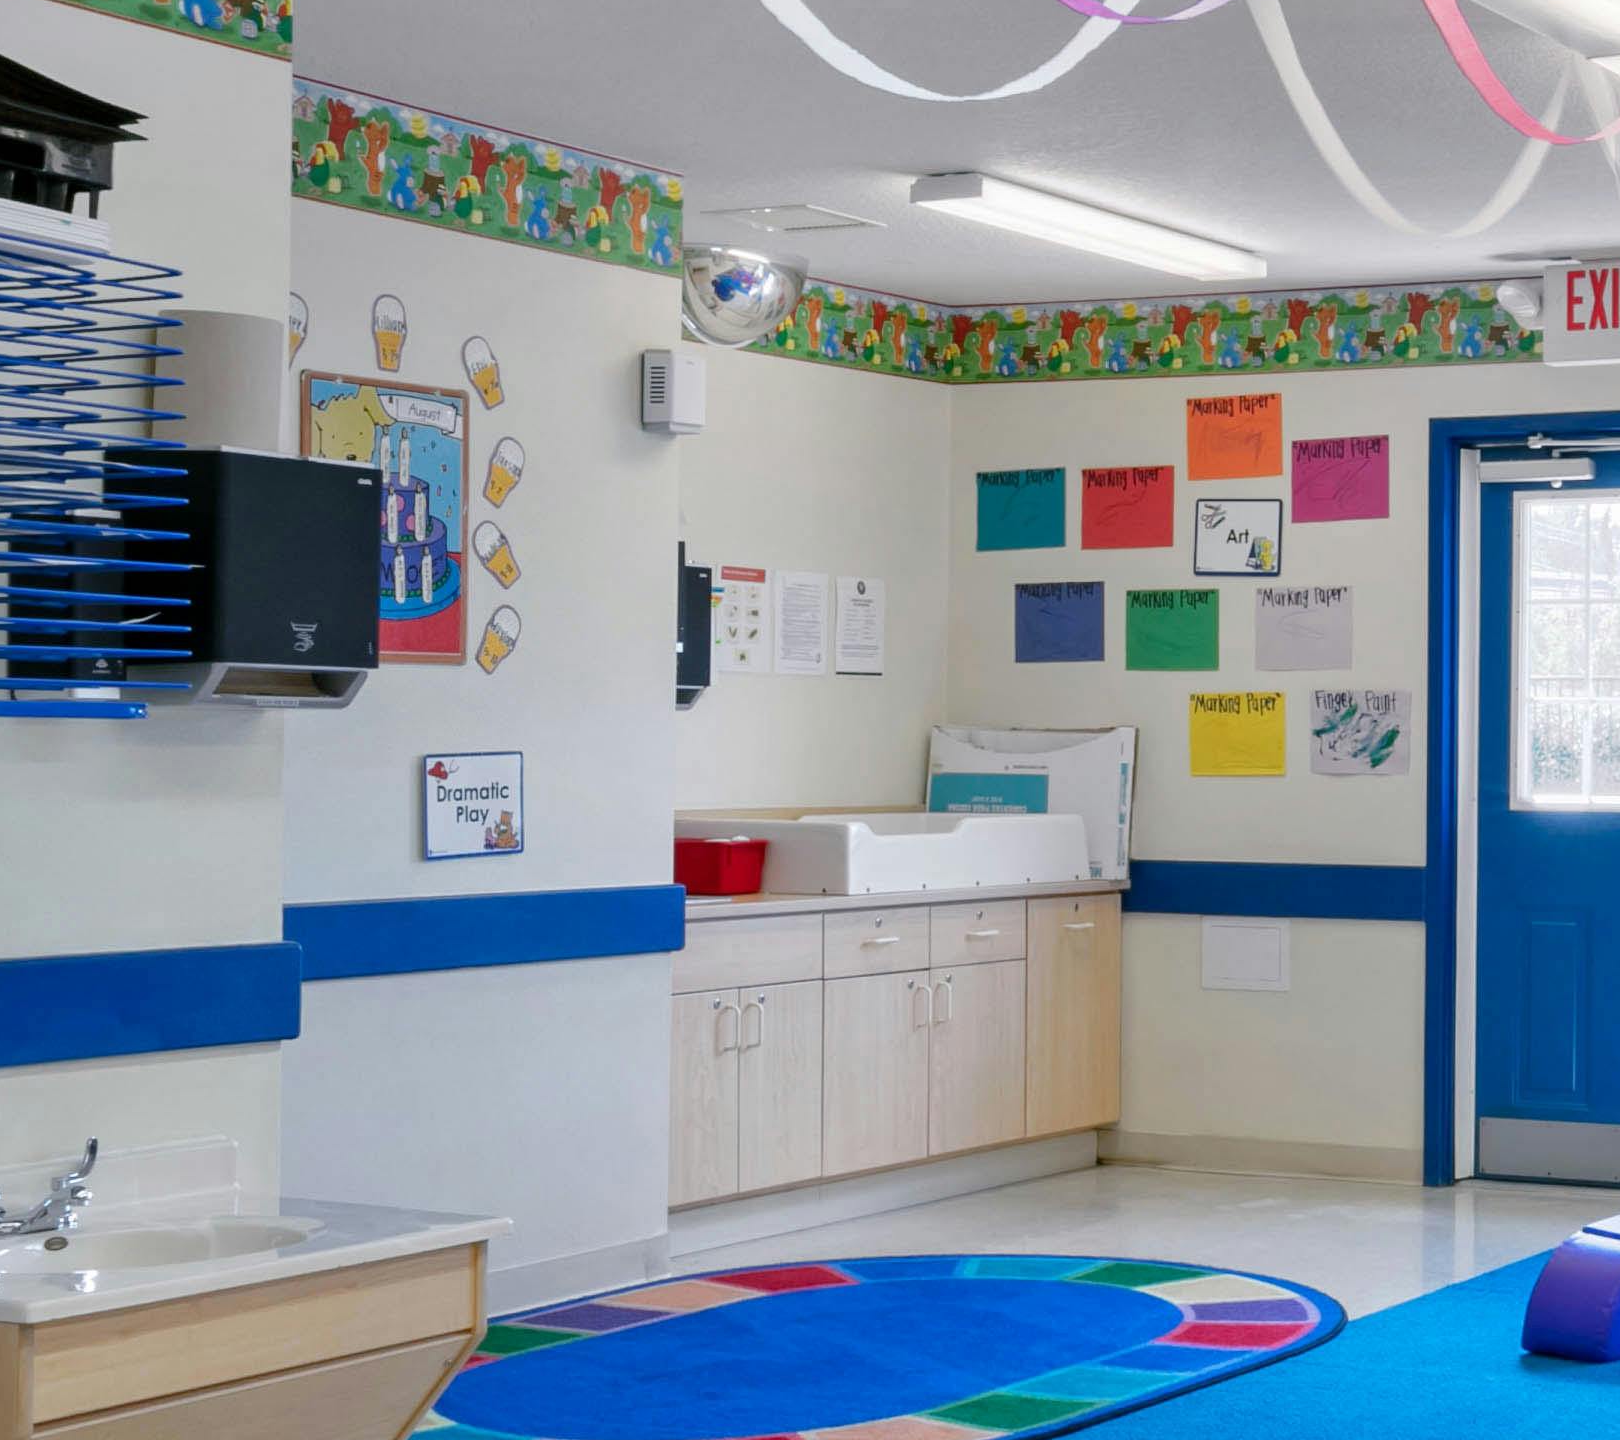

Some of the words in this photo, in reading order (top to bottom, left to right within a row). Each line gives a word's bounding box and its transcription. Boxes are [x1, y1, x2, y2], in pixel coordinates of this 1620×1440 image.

[407, 403, 443, 424] August
[1226, 529, 1250, 544] Art
[1257, 587, 1310, 609] "Marking
[1313, 586, 1348, 608] Paper"
[1190, 694, 1241, 715] "Marking
[1246, 692, 1281, 715] Paper"
[436, 781, 510, 803] Dramatic
[456, 805, 490, 826] Play
